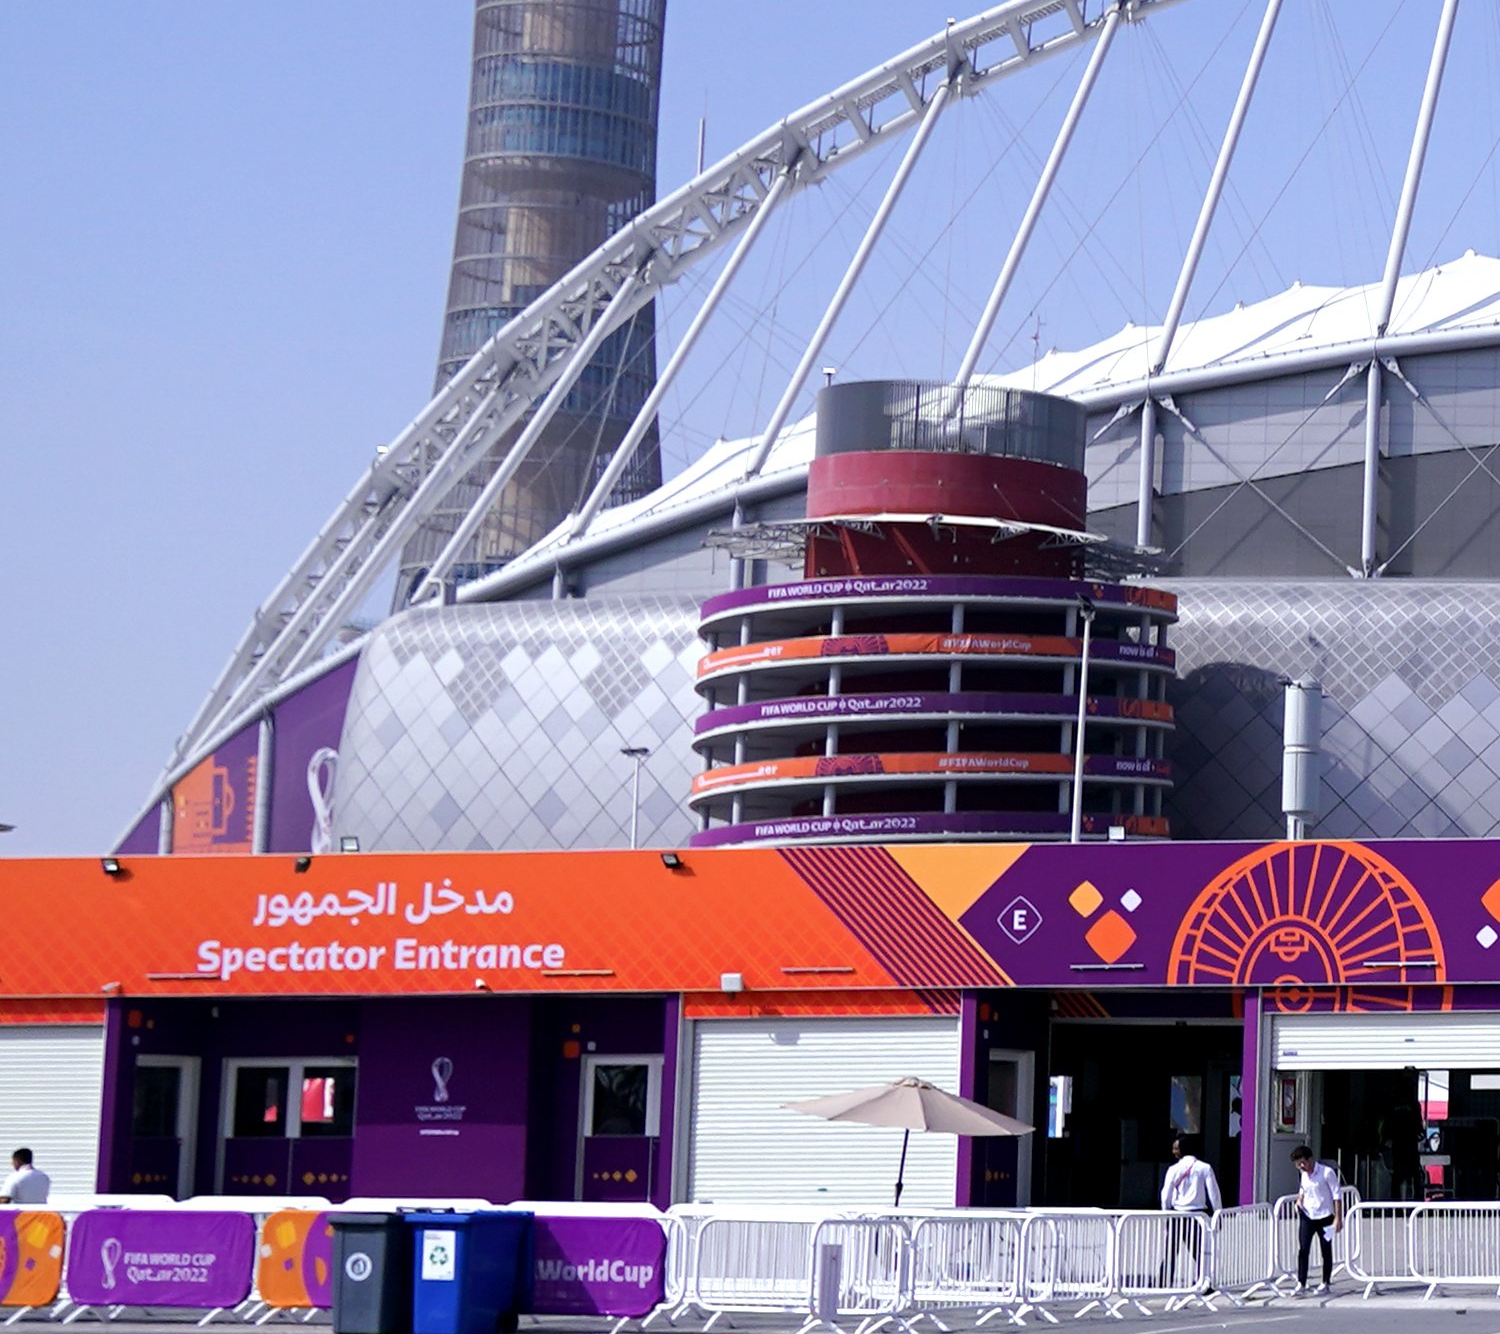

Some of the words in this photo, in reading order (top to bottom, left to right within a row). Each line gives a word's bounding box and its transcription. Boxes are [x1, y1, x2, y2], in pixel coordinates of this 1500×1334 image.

[768, 588, 787, 599] FIFA
[787, 584, 822, 597] WORLD
[823, 582, 844, 594] CUP
[853, 579, 928, 594] Qatar2022
[761, 705, 780, 716] FIFA
[781, 702, 815, 715] WORLD
[817, 700, 838, 711] CUP
[848, 697, 921, 711] Qatar2022
[755, 825, 775, 836] FIFA
[775, 822, 809, 835] WORLD
[811, 820, 832, 832] CUP
[842, 817, 916, 832] Qatar2022
[252, 882, 397, 927] الجمهور
[404, 878, 514, 924] مدخل
[1013, 909, 1027, 930] E
[197, 939, 386, 980] Spectator
[394, 938, 565, 970] Entrance
[124, 1252, 148, 1265] FIFA
[149, 1253, 191, 1266] WORLD
[192, 1253, 216, 1266] CUP
[127, 1266, 207, 1284] Qatar2022
[537, 1259, 653, 1288] WorldCup
